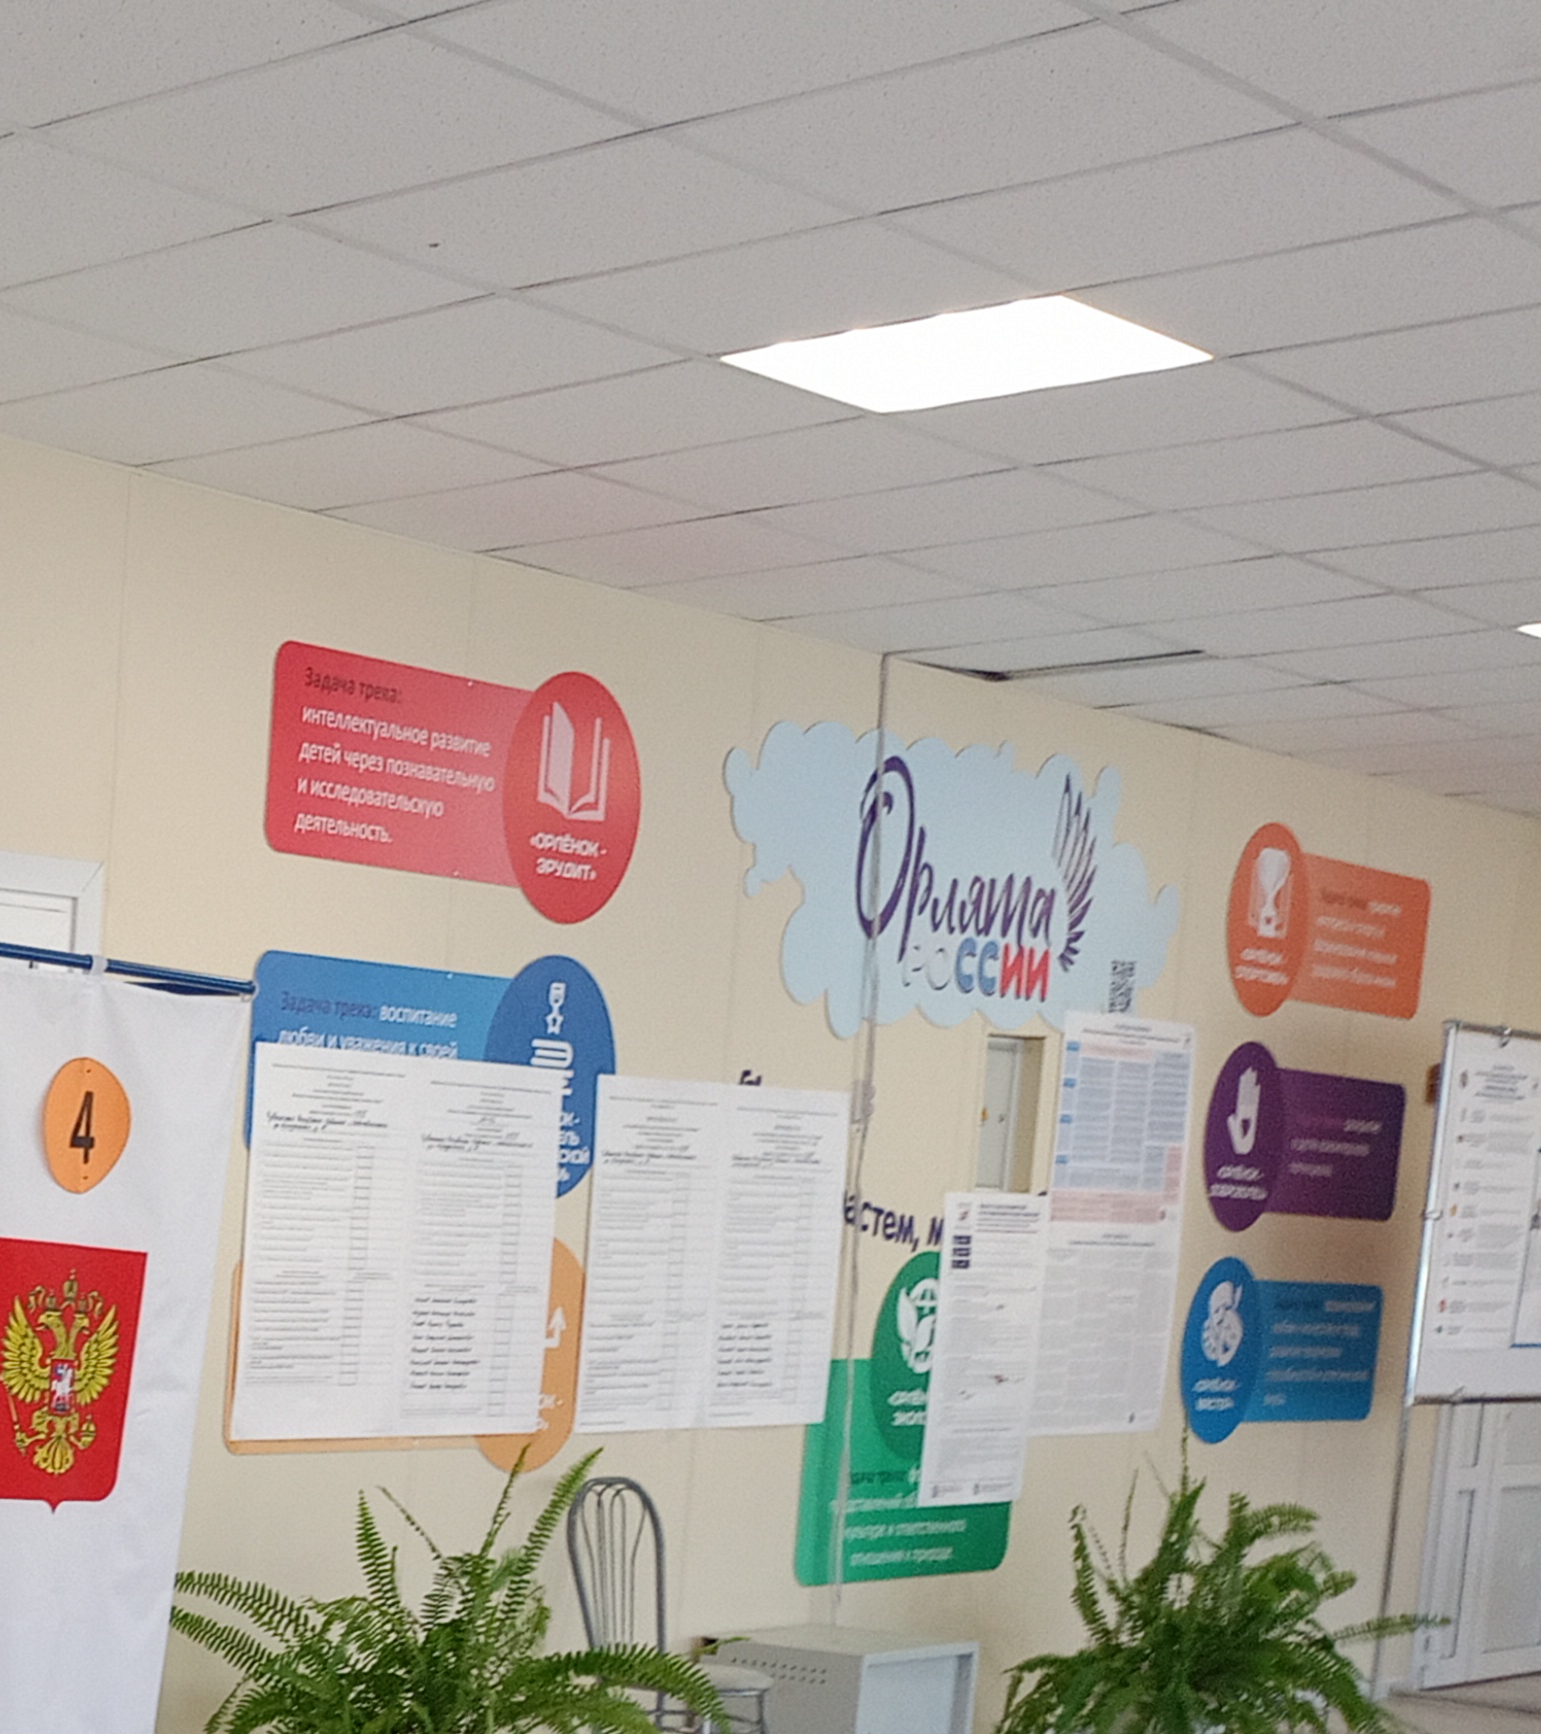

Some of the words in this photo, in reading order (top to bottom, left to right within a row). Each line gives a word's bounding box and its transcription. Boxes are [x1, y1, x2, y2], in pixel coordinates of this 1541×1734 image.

[304, 667, 355, 696] Задача
[360, 682, 402, 704] трека:
[302, 705, 428, 746] интеллектуальное
[430, 732, 492, 758] развитие
[298, 742, 342, 764] детей
[344, 751, 384, 774] через
[386, 759, 496, 794] познавательную
[297, 778, 307, 793] и
[310, 781, 444, 819] исследовательскую
[293, 813, 394, 843] деятельность.
[854, 756, 1057, 964] Орлята
[902, 936, 1053, 1002] РОССИИ
[379, 1005, 458, 1029] воспитание
[68, 1091, 96, 1165] 4
